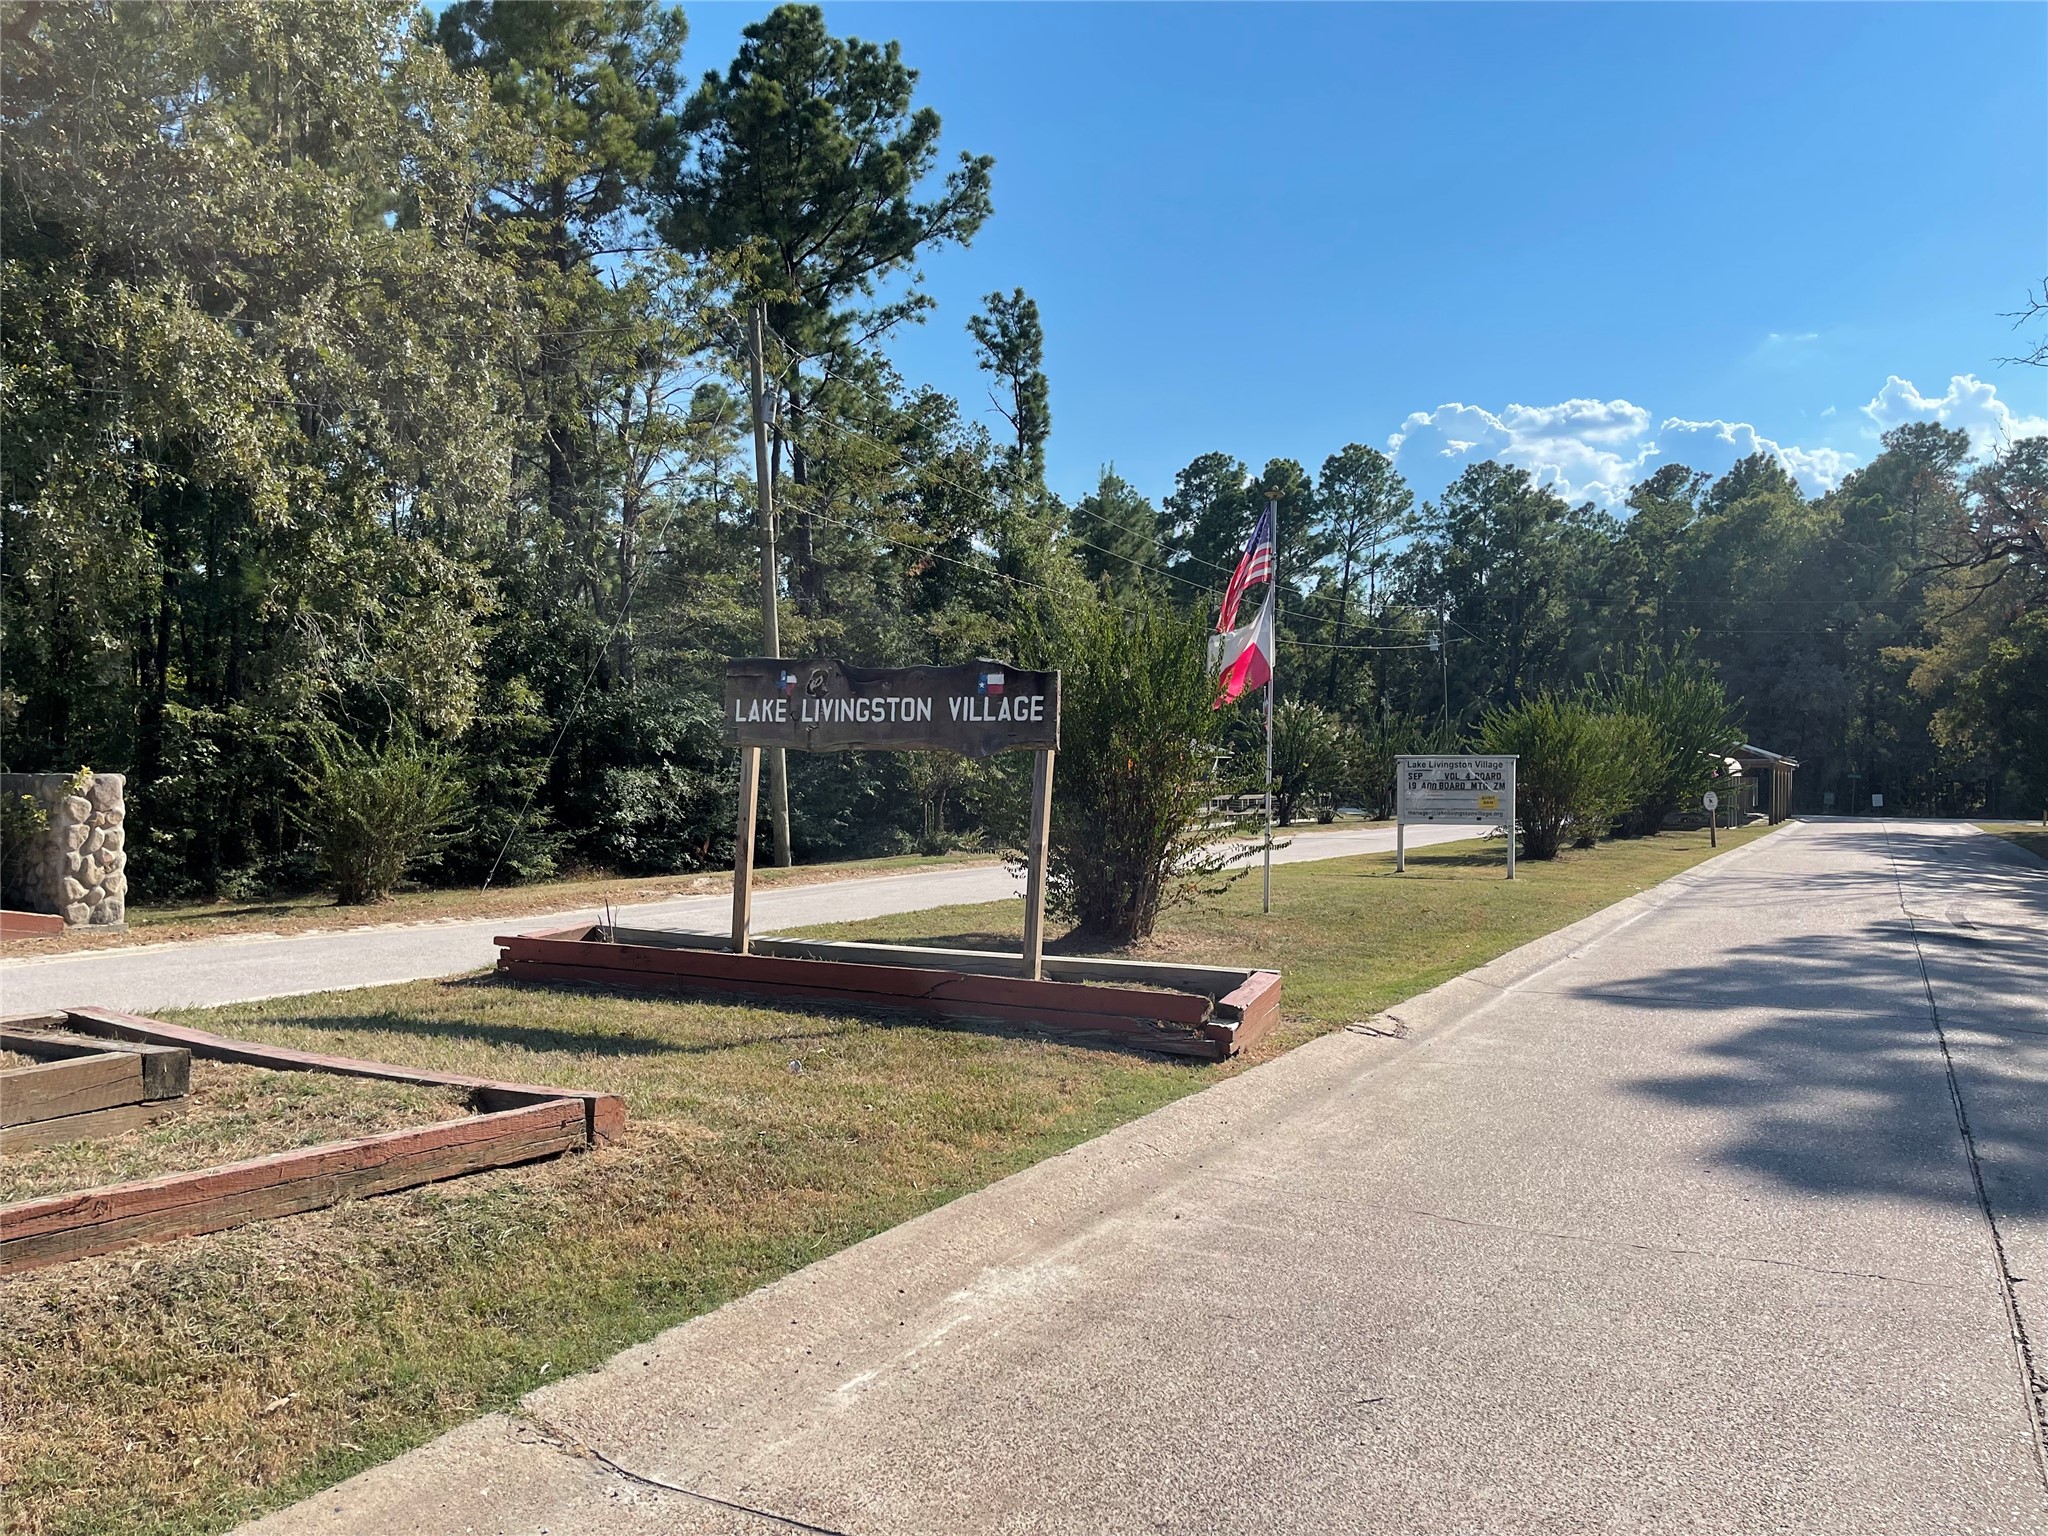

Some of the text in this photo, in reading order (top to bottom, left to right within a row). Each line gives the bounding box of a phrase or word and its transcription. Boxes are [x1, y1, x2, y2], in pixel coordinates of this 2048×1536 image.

[735, 695, 1045, 723] LAKE LIVINGSTON VILLAGE
[1407, 761, 1504, 770] Lake Livingston Village
[1407, 772, 1423, 780] SEP
[1444, 772, 1460, 780] VOL
[1408, 782, 1417, 790] 19
[1438, 782, 1466, 790] BOARD
